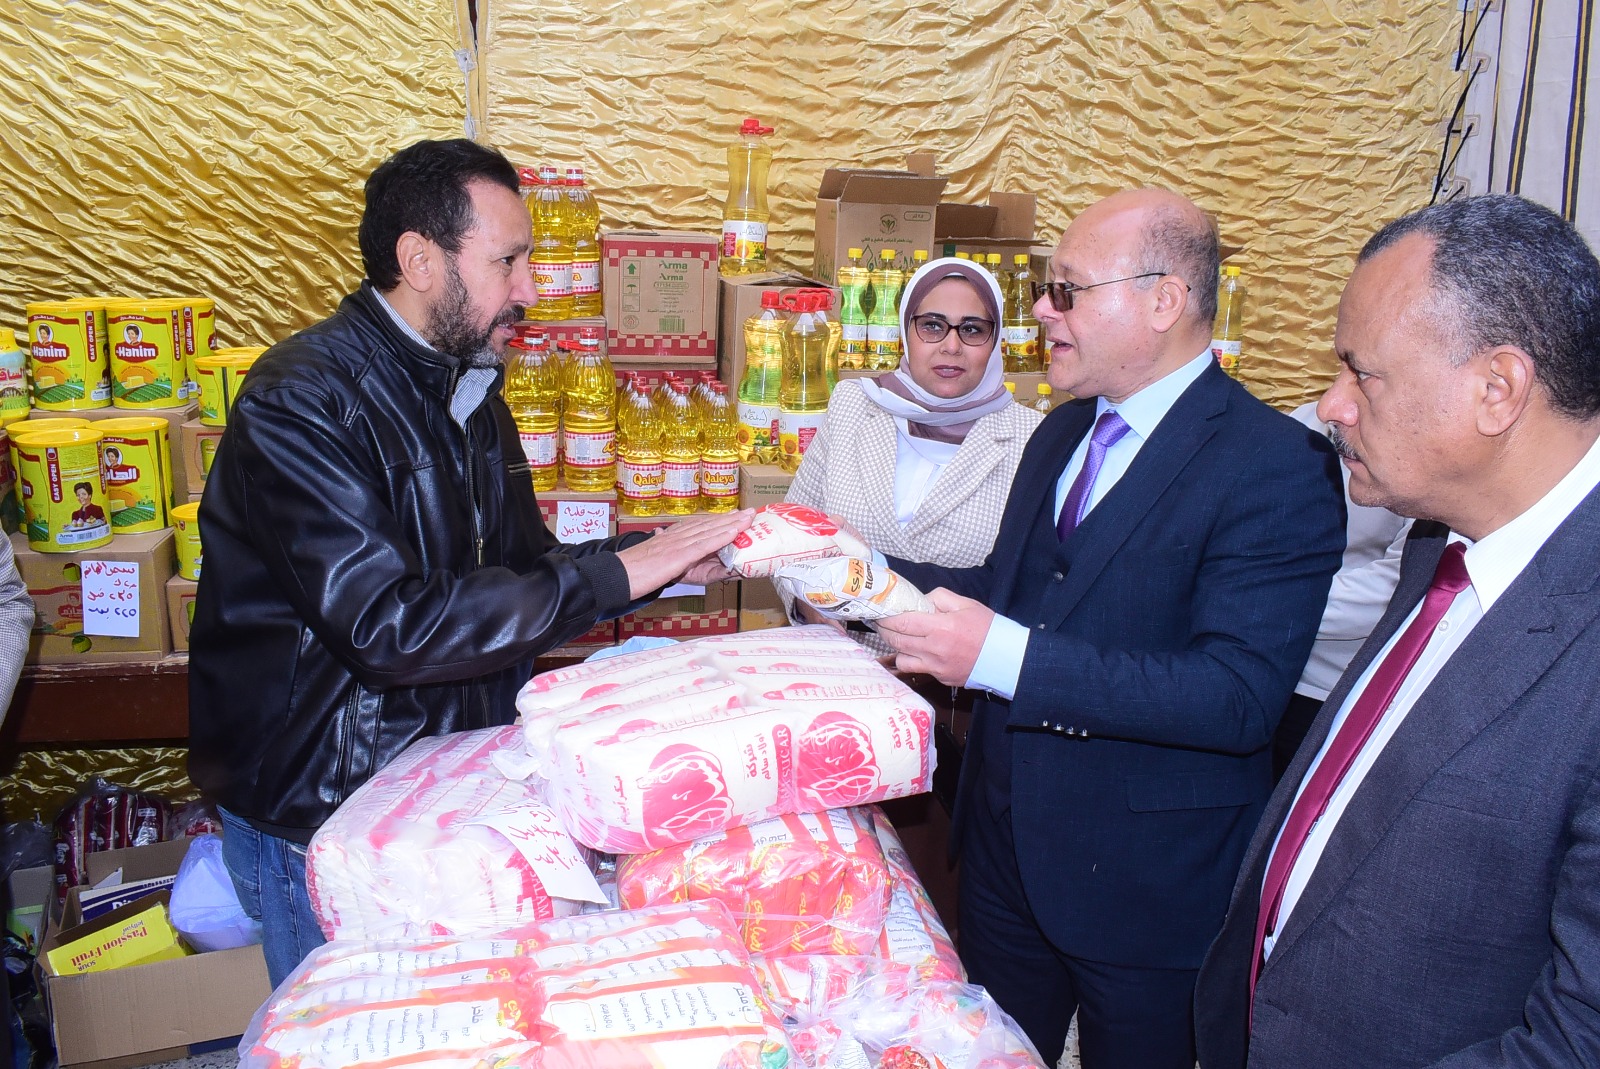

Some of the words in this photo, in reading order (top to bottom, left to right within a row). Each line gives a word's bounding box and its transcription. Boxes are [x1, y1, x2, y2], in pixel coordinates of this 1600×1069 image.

[659, 260, 688, 270] Arma
[533, 272, 553, 285] leya
[659, 273, 684, 281] Arma
[50, 464, 58, 483] OPEN
[703, 472, 735, 485] Qaleya
[52, 483, 60, 501] EASY
[887, 716, 902, 749] شركة
[904, 728, 916, 751] سالم
[743, 743, 758, 778] شركة
[761, 757, 772, 780] سالم
[102, 926, 148, 952] Passion
[70, 947, 103, 968] Fruit
[77, 960, 96, 972] SOUR
